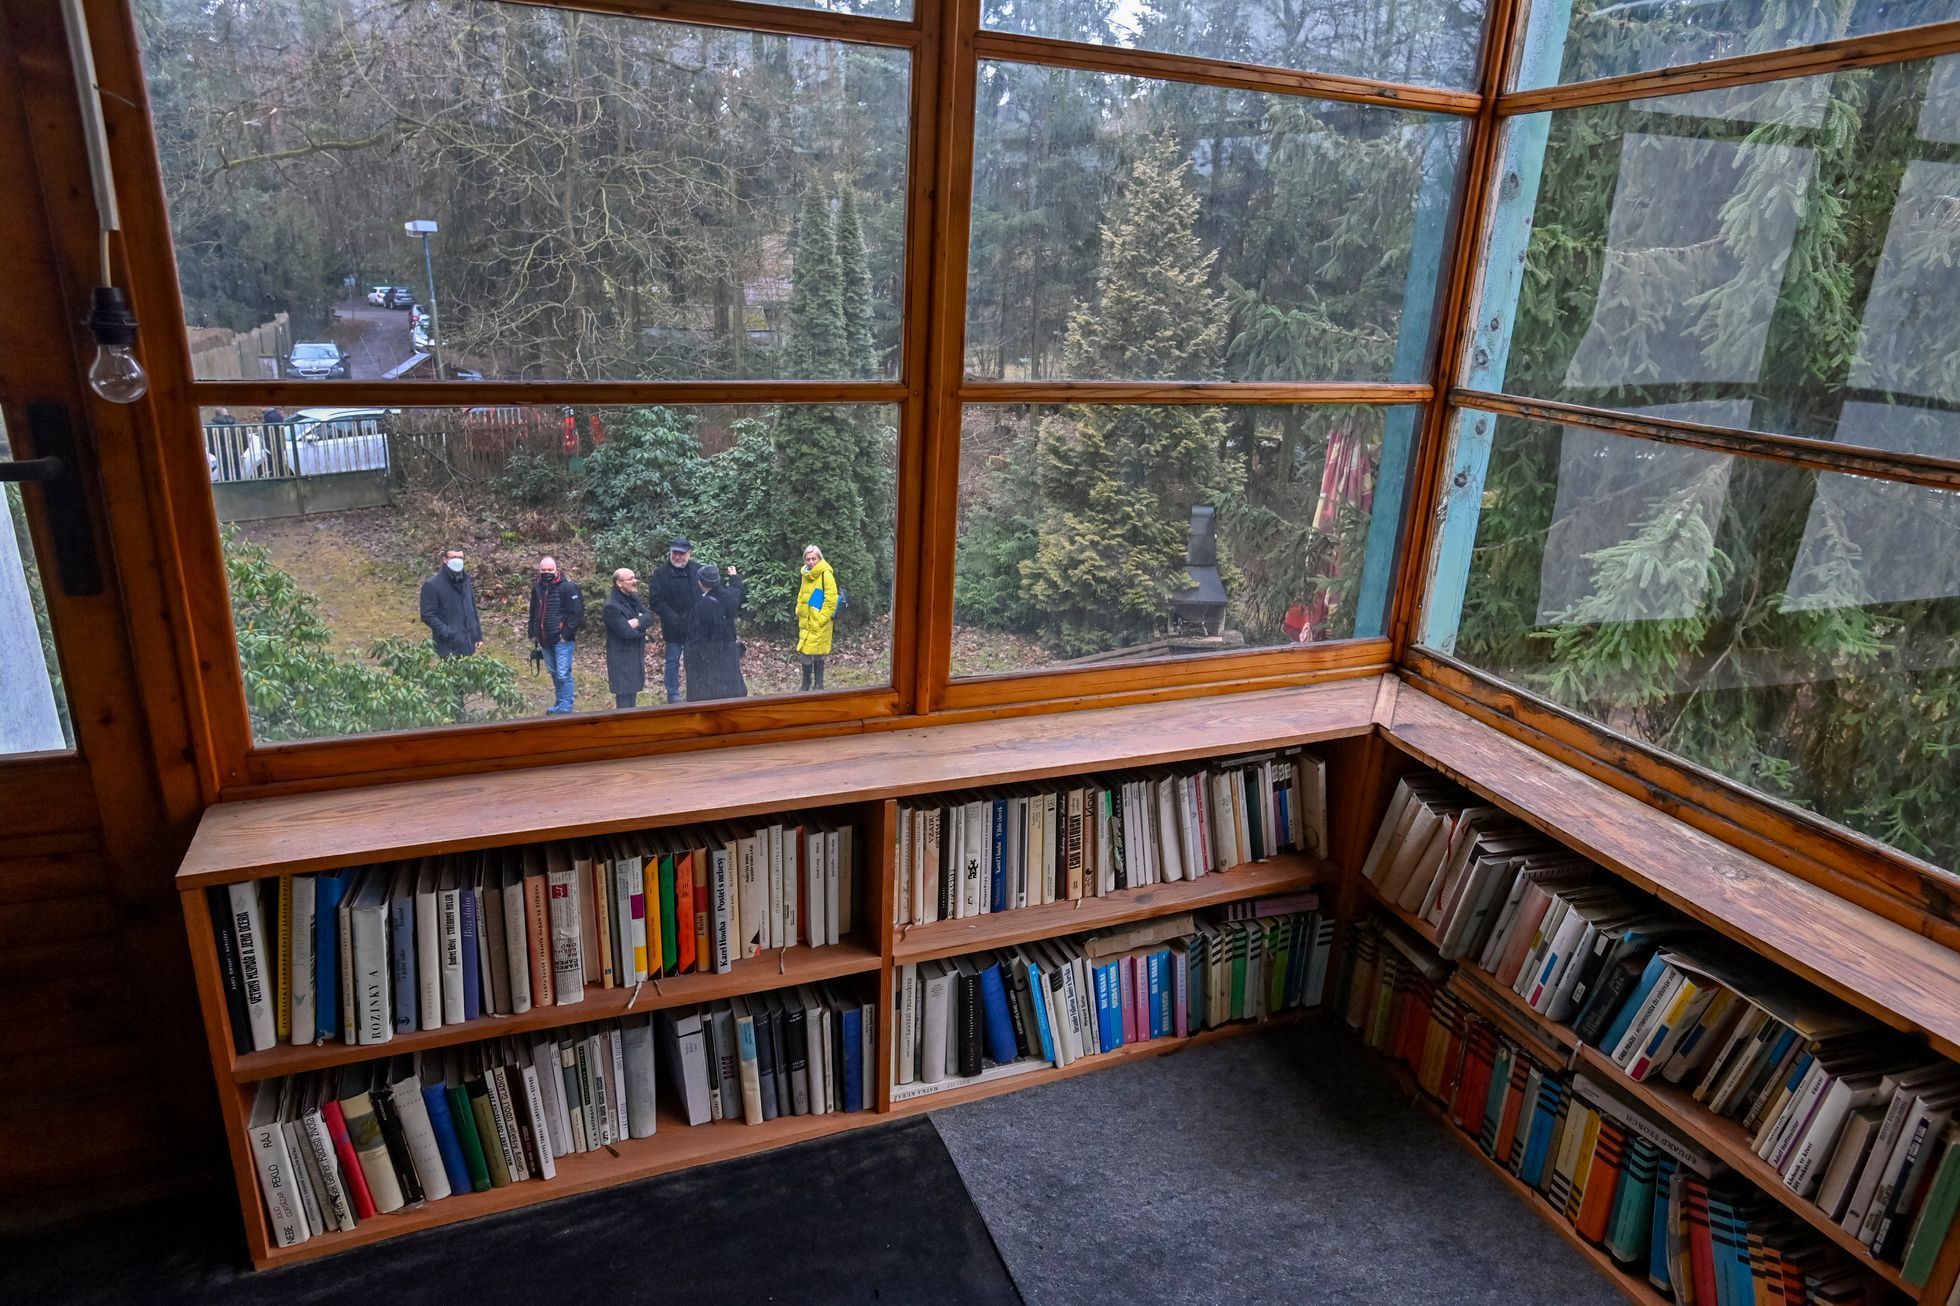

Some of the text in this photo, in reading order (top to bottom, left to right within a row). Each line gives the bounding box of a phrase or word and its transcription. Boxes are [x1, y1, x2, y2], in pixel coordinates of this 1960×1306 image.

[1085, 792, 1095, 818] Vian
[716, 857, 725, 883] nebesy
[1068, 851, 1081, 870] EGON
[444, 894, 454, 911] HOLUB
[717, 889, 725, 912] Postel
[236, 911, 251, 933] DCERA
[462, 897, 474, 938] Boží duha
[240, 932, 254, 948] JEHO
[718, 921, 727, 946] Houba
[242, 955, 258, 980] MLYNÁŘ
[719, 946, 728, 967] Karel
[244, 980, 262, 1005] VĚTRNÝ
[369, 985, 381, 1039] ROZINKY
[494, 1072, 508, 1100] GLADIOL
[303, 1117, 319, 1139] života
[505, 1124, 518, 1150] Aršakjan
[260, 1132, 273, 1149] RÁJ
[1626, 1115, 1697, 1165] EDUARD ŠTORCH
[512, 1151, 524, 1173] Gevorg
[1773, 1149, 1784, 1165] Adolf
[268, 1164, 282, 1188] PEKLO
[273, 1206, 284, 1220] JULIO
[277, 1191, 293, 1219] CORTÁZAR
[283, 1225, 295, 1244] NEBE
